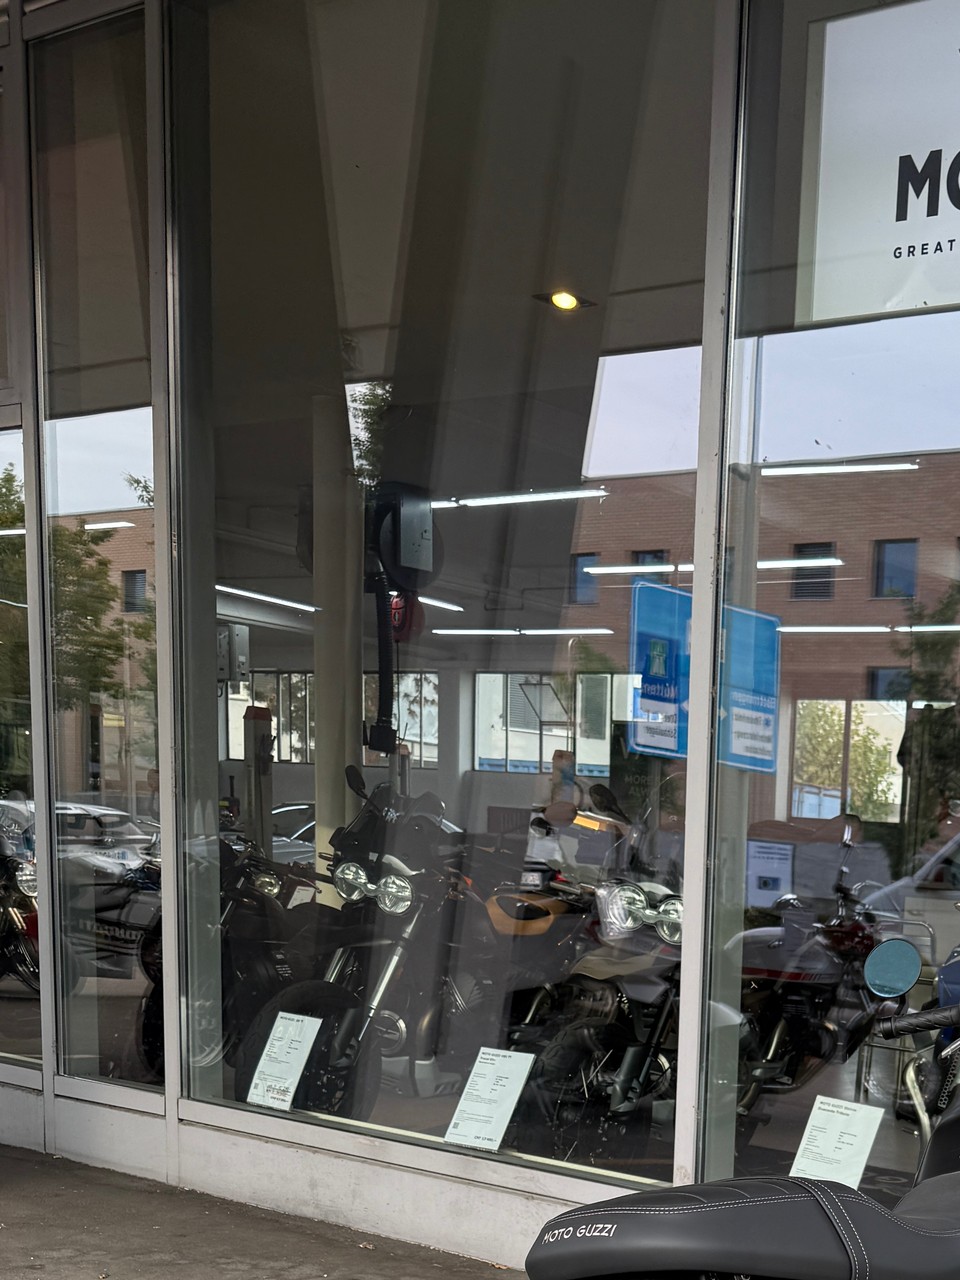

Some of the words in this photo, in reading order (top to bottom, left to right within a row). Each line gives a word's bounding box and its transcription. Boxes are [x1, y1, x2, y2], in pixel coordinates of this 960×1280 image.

[893, 239, 956, 259] GREAT
[542, 1227, 573, 1244] MOTO
[576, 1223, 617, 1238] GUZZI
